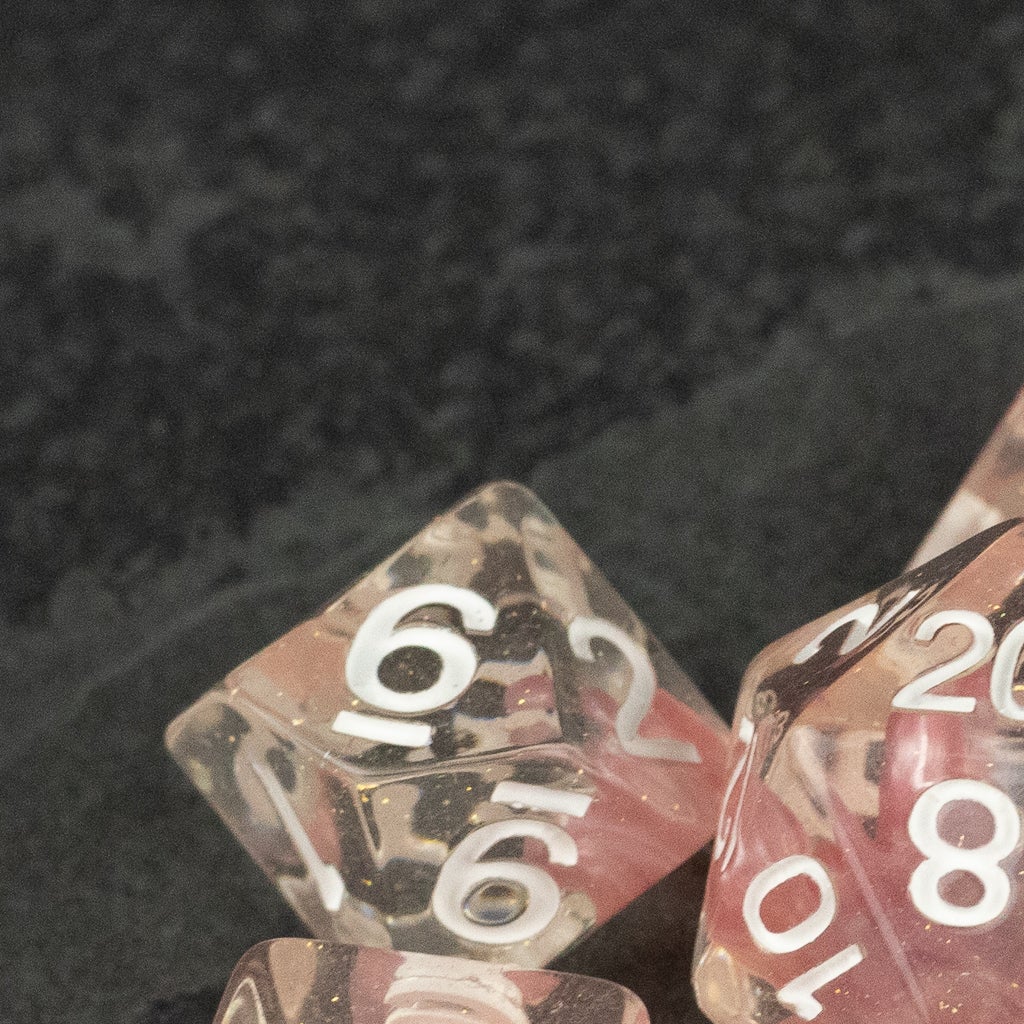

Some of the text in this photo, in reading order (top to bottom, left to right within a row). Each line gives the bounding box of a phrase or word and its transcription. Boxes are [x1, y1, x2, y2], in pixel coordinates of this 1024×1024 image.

[332, 584, 500, 747] 6
[568, 617, 701, 763] 2
[908, 779, 1022, 927] 8
[742, 854, 866, 1021] 10
